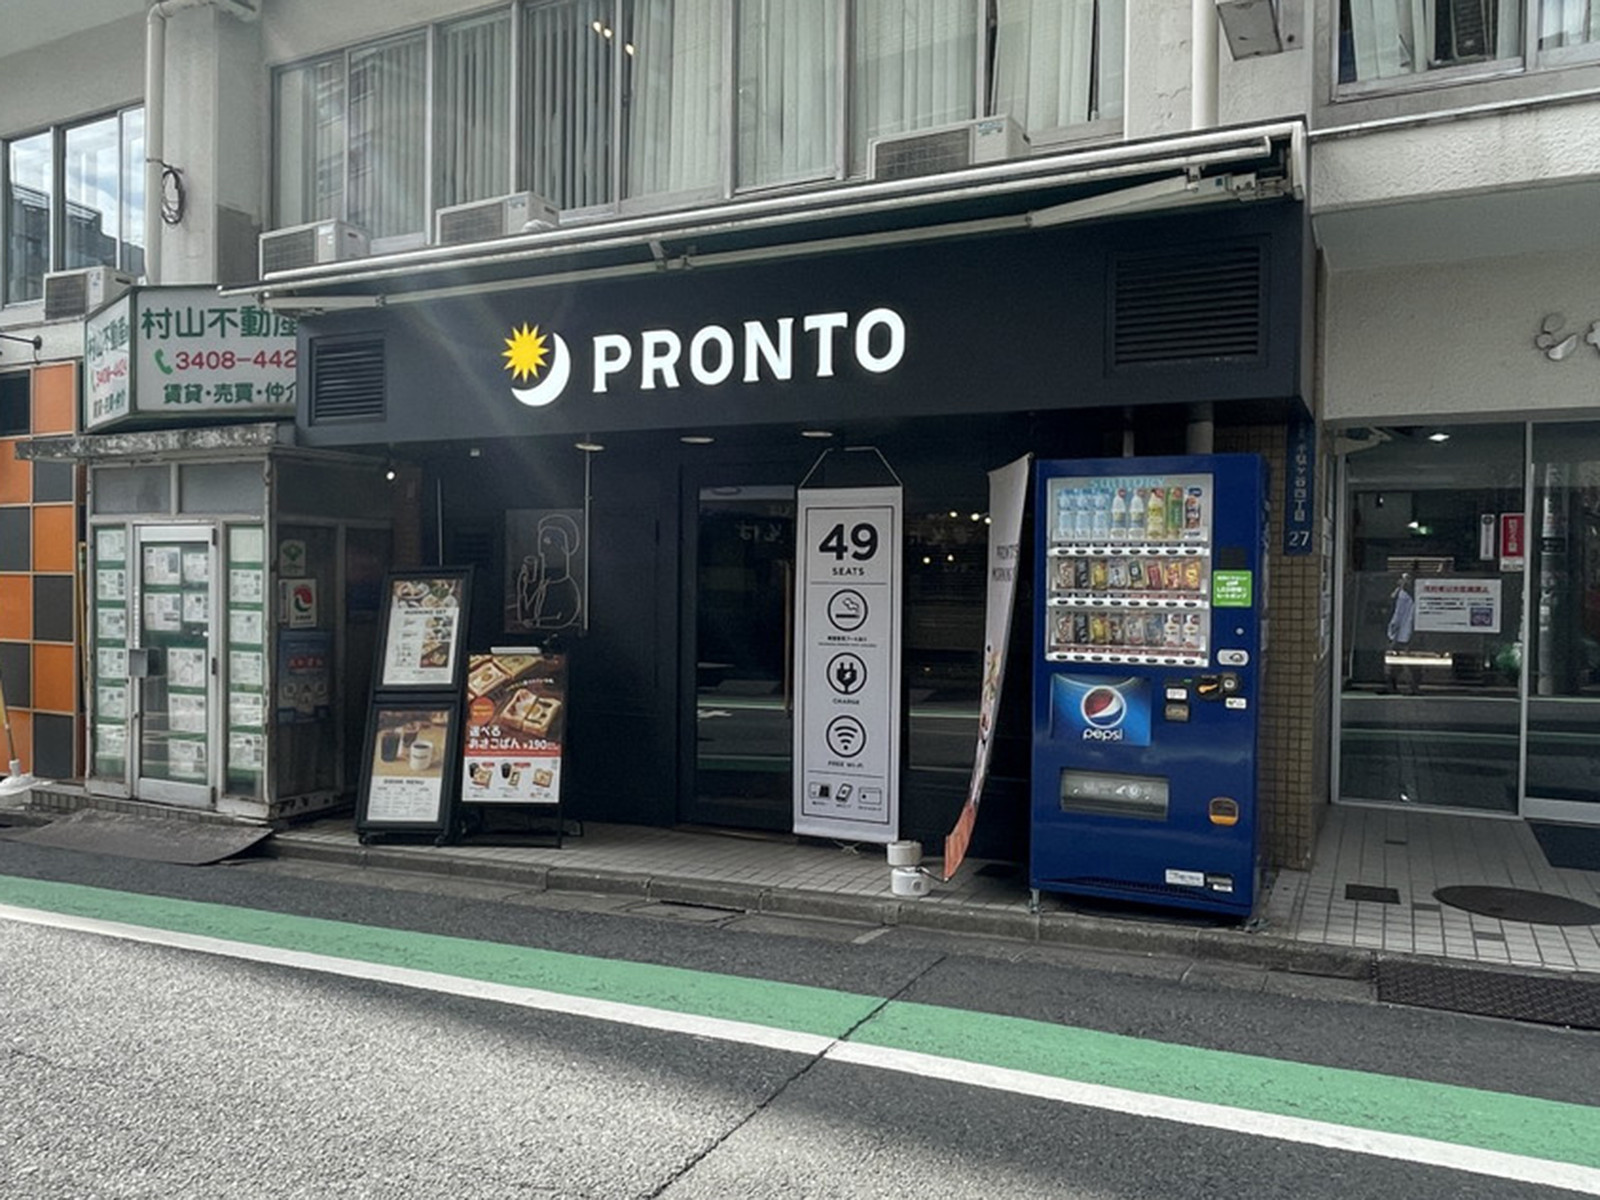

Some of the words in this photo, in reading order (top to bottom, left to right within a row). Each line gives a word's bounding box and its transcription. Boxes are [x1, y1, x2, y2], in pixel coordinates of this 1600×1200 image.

[141, 305, 297, 340] 村山不動産
[592, 307, 906, 393] PRONTO
[818, 522, 879, 561] 49
[1289, 531, 1310, 547] 27
[832, 567, 865, 576] SEATS
[832, 697, 860, 705] CHARGE
[1083, 728, 1123, 741] pepsi
